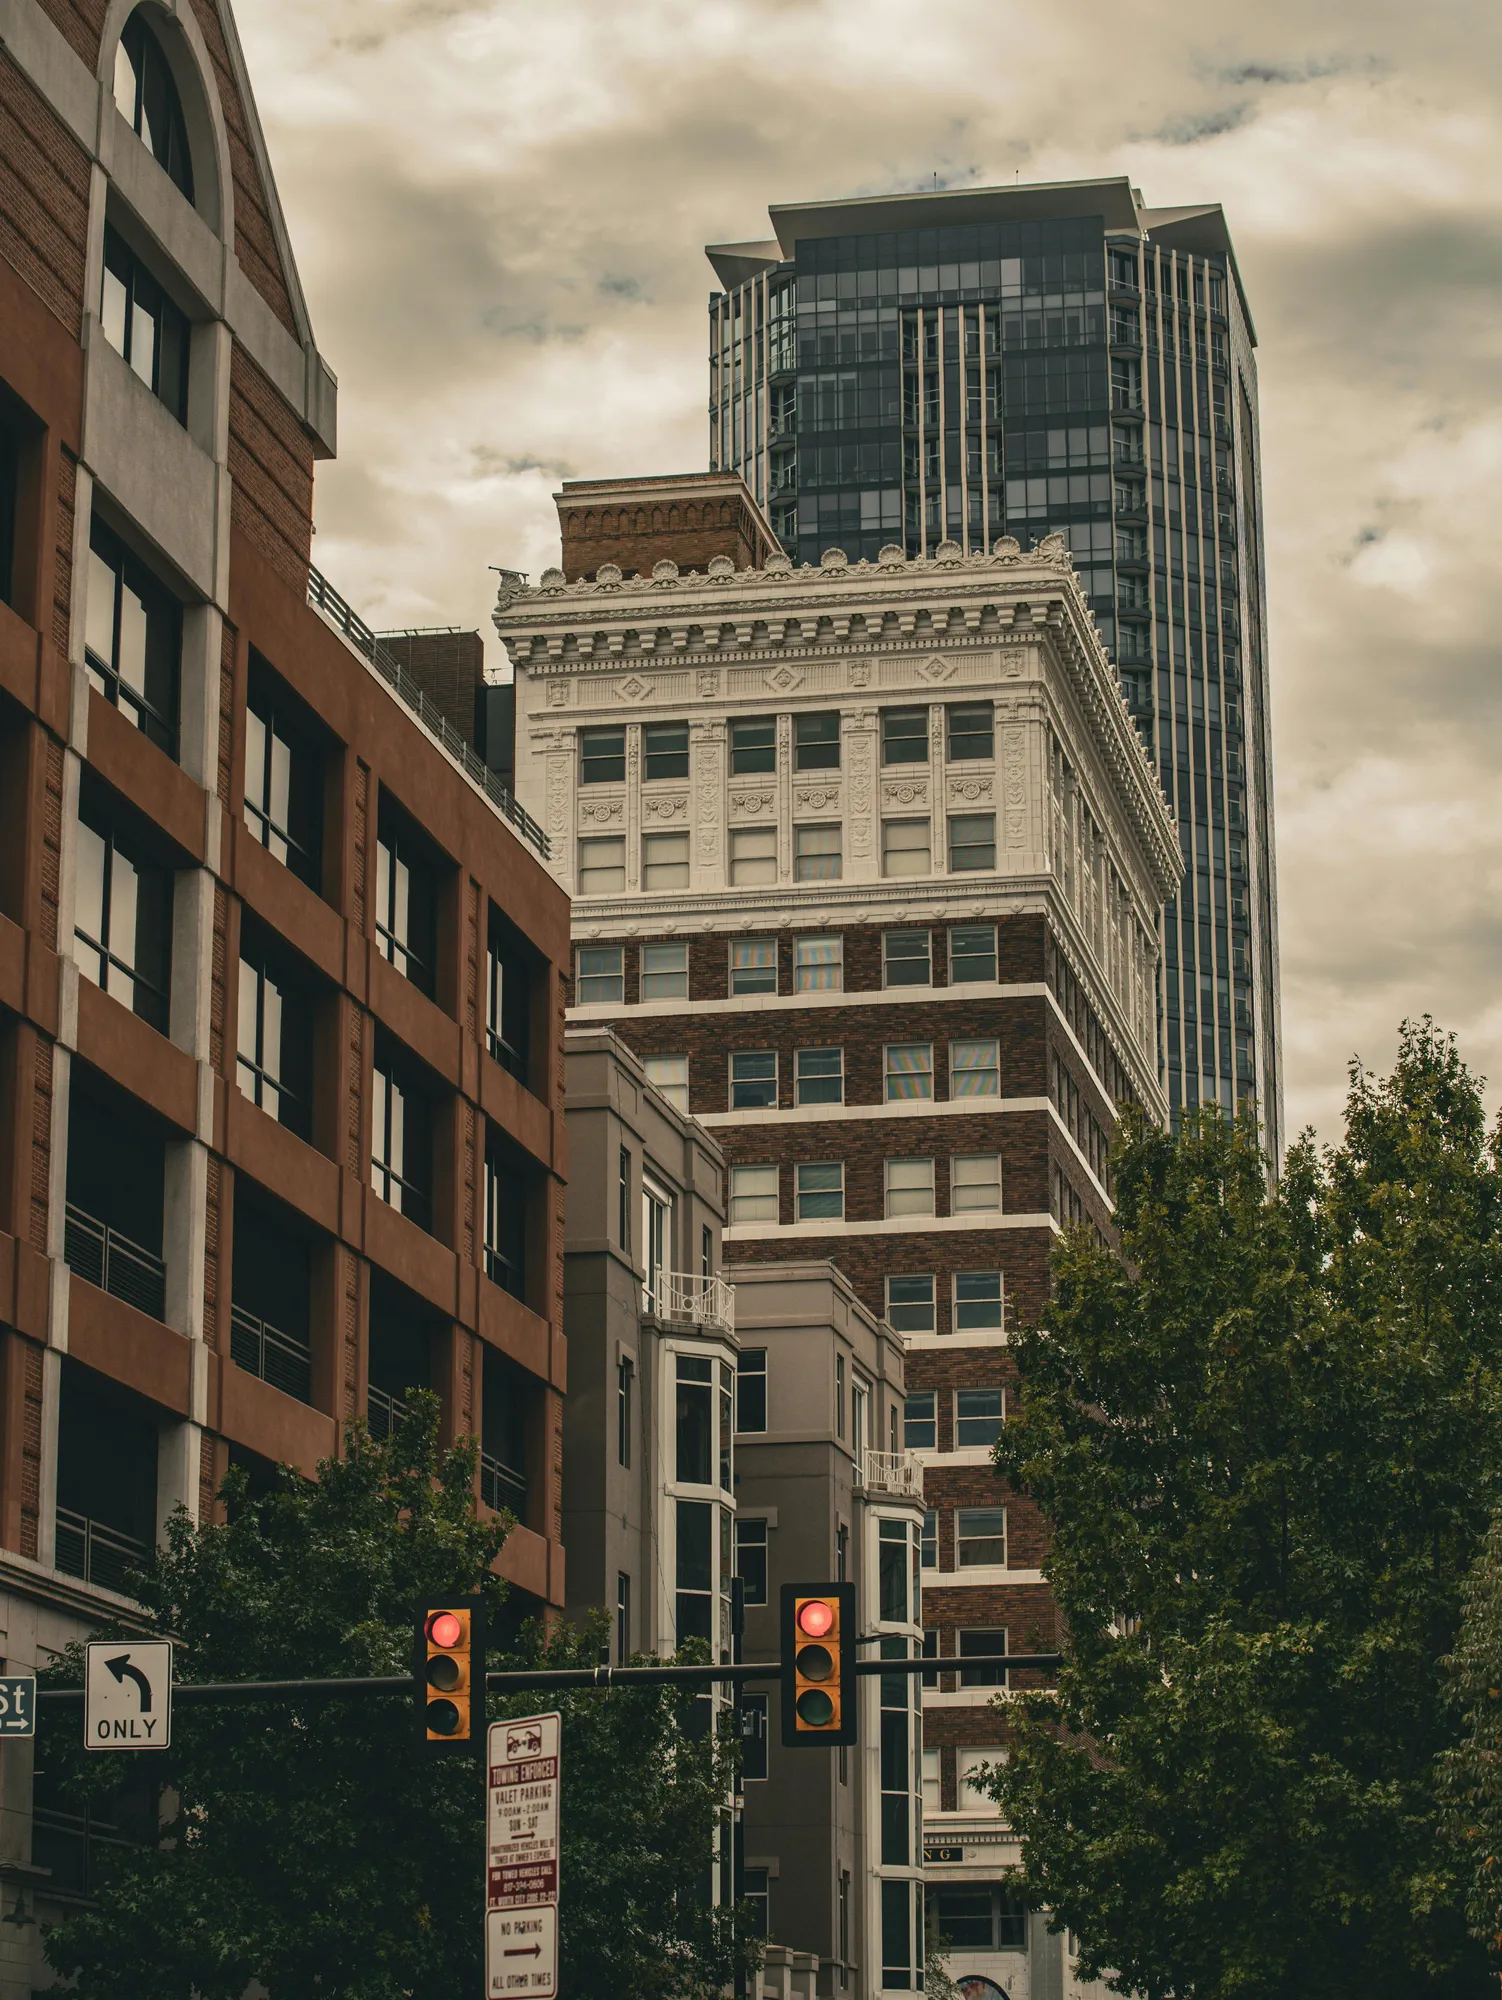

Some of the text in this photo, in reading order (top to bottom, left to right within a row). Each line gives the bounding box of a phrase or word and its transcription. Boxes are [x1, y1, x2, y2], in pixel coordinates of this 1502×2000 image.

[98, 1719, 157, 1739] ONLY
[492, 1760, 555, 1785] TOWING ENFORCED
[496, 1784, 552, 1804] VALET PARKING
[509, 1819, 520, 1831] SUN
[528, 1816, 538, 1828] SAT
[491, 1871, 501, 1881] FOR
[502, 1869, 518, 1879] TOWED
[519, 1866, 540, 1877] VEHICLES
[515, 1894, 525, 1904] CITY
[501, 1919, 542, 1936] NO PARKING
[492, 1972, 551, 1989] ALL OTHER TIMES
